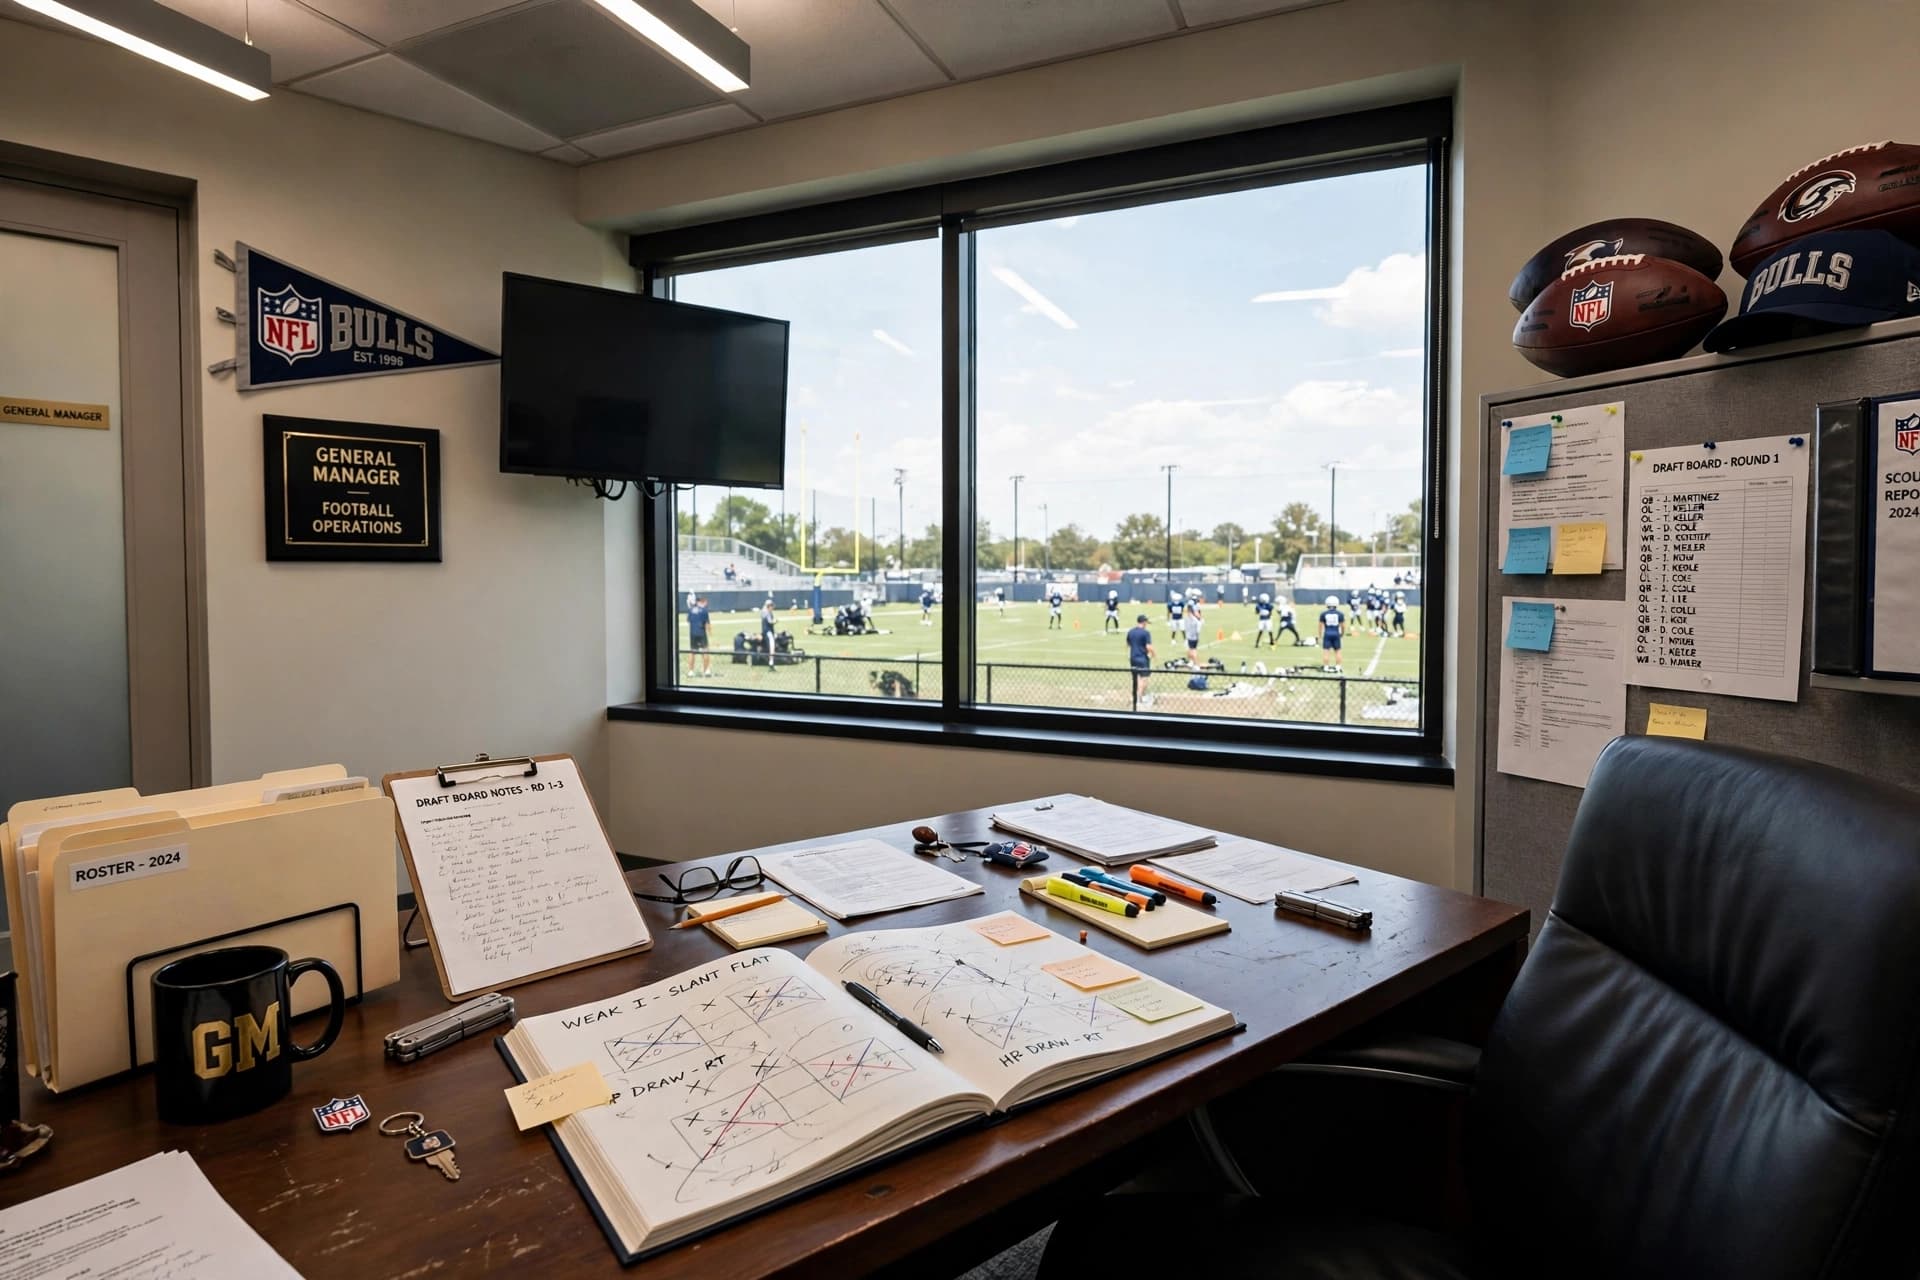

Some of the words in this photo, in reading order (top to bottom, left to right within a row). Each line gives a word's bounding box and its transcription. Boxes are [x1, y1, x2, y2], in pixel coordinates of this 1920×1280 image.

[1747, 250, 1854, 313] BULLS
[1574, 300, 1606, 324] NFL
[264, 316, 316, 352] NFL
[330, 303, 434, 361] BULLS
[353, 350, 377, 365] EST.
[379, 353, 404, 367] 1996
[3, 405, 51, 418] GENERAL
[53, 409, 103, 422] MANAGER
[316, 446, 397, 467] GENERAL
[1653, 461, 1685, 473] DRAFT
[1686, 458, 1722, 470] BOARD
[1731, 455, 1770, 467] ROUND
[1773, 453, 1780, 464] 1
[313, 466, 401, 486] MANAGER
[1885, 471, 1920, 484] SCOU
[1673, 493, 1720, 502] MARTINEZ
[1885, 488, 1920, 501] REPO
[322, 501, 394, 517] FOOTBALL
[1888, 506, 1920, 519] 2024
[312, 519, 403, 535] OPERATIONS
[1671, 626, 1695, 635] COLE
[416, 795, 450, 808] DRAFT
[452, 790, 489, 803] BOARD
[491, 786, 523, 798] NOTES
[531, 783, 545, 792] RD
[548, 780, 564, 789] 1-3
[75, 861, 136, 883] ROSTER
[149, 851, 182, 869] 2024
[561, 1005, 624, 1031] WEAK
[633, 996, 648, 1010] I
[669, 969, 721, 997] SLANT
[730, 954, 773, 974] FLAT
[191, 1001, 281, 1080] GM
[1025, 1038, 1070, 1055] DRAW
[1083, 1032, 1104, 1042] RT
[631, 1071, 686, 1098] DRAW
[705, 1054, 727, 1071] RT
[323, 1107, 363, 1127] NFL
